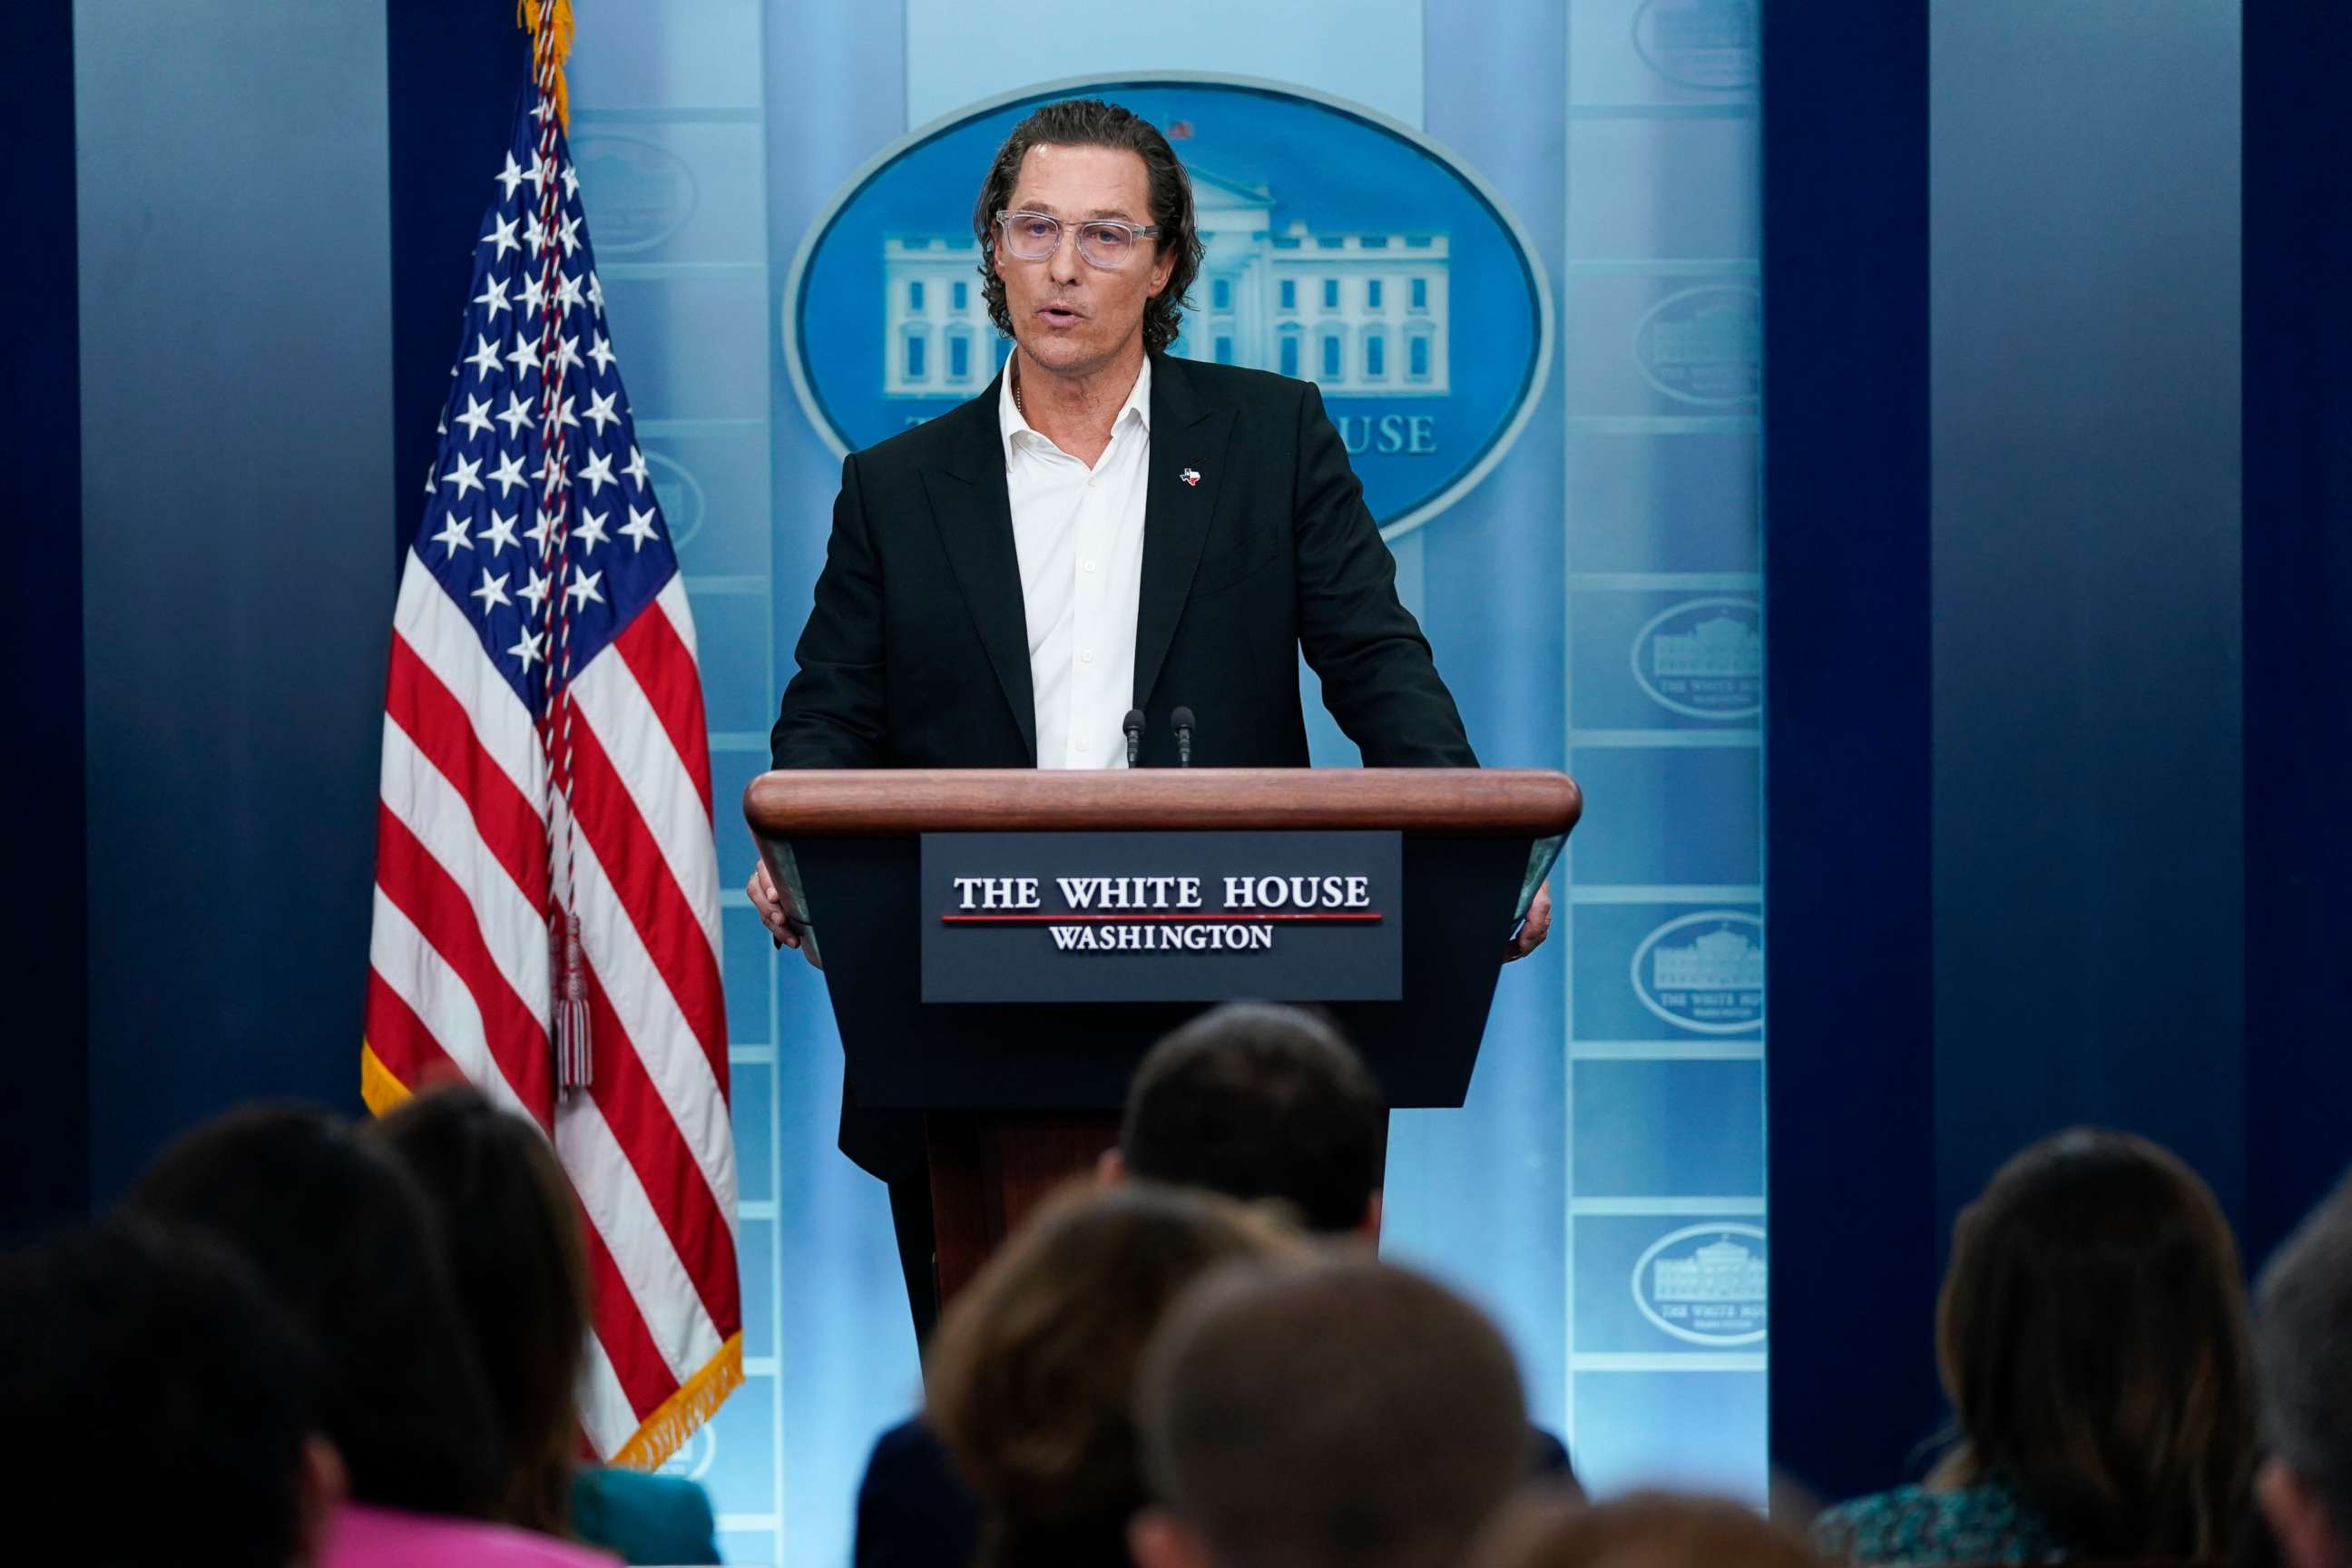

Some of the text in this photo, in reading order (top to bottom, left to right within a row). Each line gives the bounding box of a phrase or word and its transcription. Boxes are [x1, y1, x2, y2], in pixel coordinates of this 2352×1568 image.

[1338, 415, 1437, 454] USE
[954, 876, 1370, 908] THE WHITE HOUSE
[1049, 925, 1273, 949] WASHINGTON
